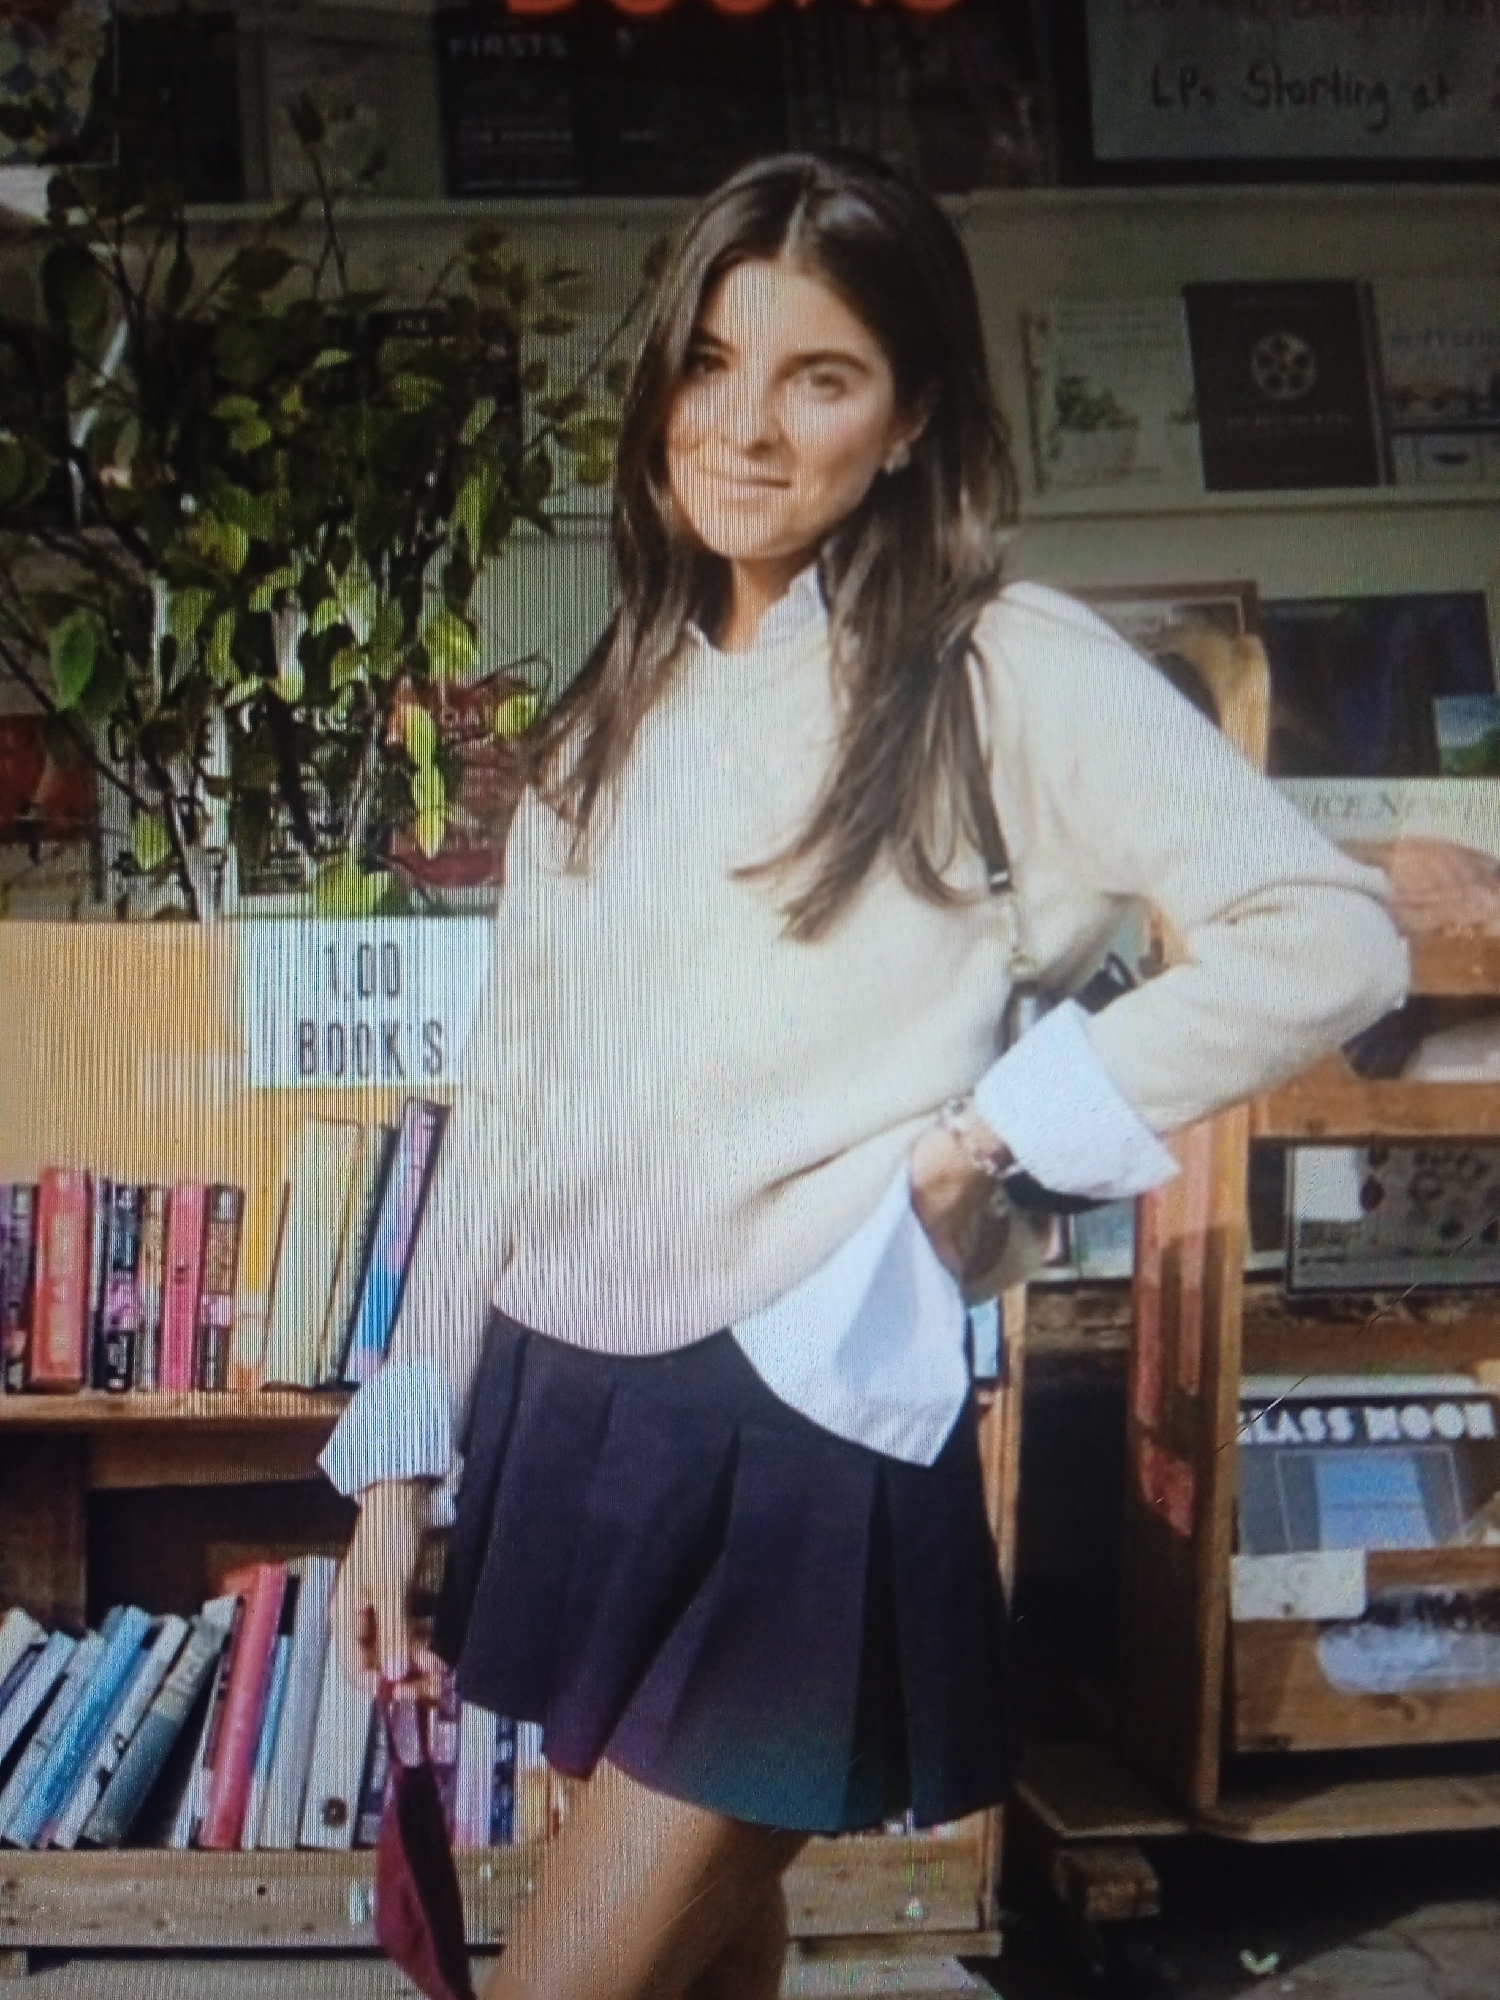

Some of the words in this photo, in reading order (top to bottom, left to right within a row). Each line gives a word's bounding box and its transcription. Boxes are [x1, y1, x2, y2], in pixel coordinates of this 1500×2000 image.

[1241, 57, 1391, 133] Starting
[1413, 70, 1452, 111] at
[1362, 1402, 1497, 1442] MOON
